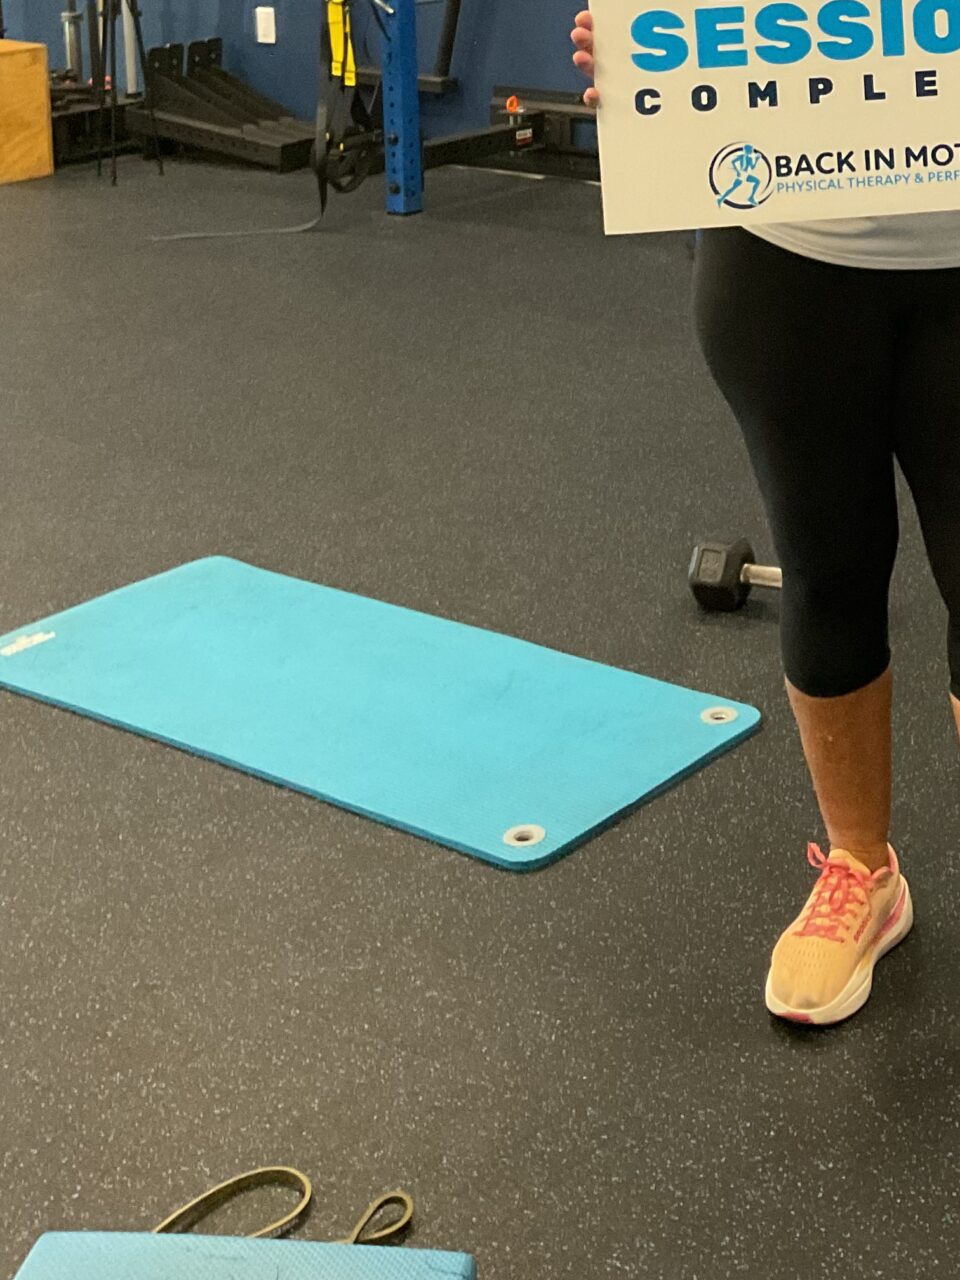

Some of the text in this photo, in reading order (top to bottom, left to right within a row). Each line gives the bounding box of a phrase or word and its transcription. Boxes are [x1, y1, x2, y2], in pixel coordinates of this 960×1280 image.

[775, 150, 857, 178] BACK
[864, 147, 895, 172] IN
[776, 178, 845, 193] PHYSICAL
[847, 173, 911, 189] THERAPY
[914, 172, 924, 184] &
